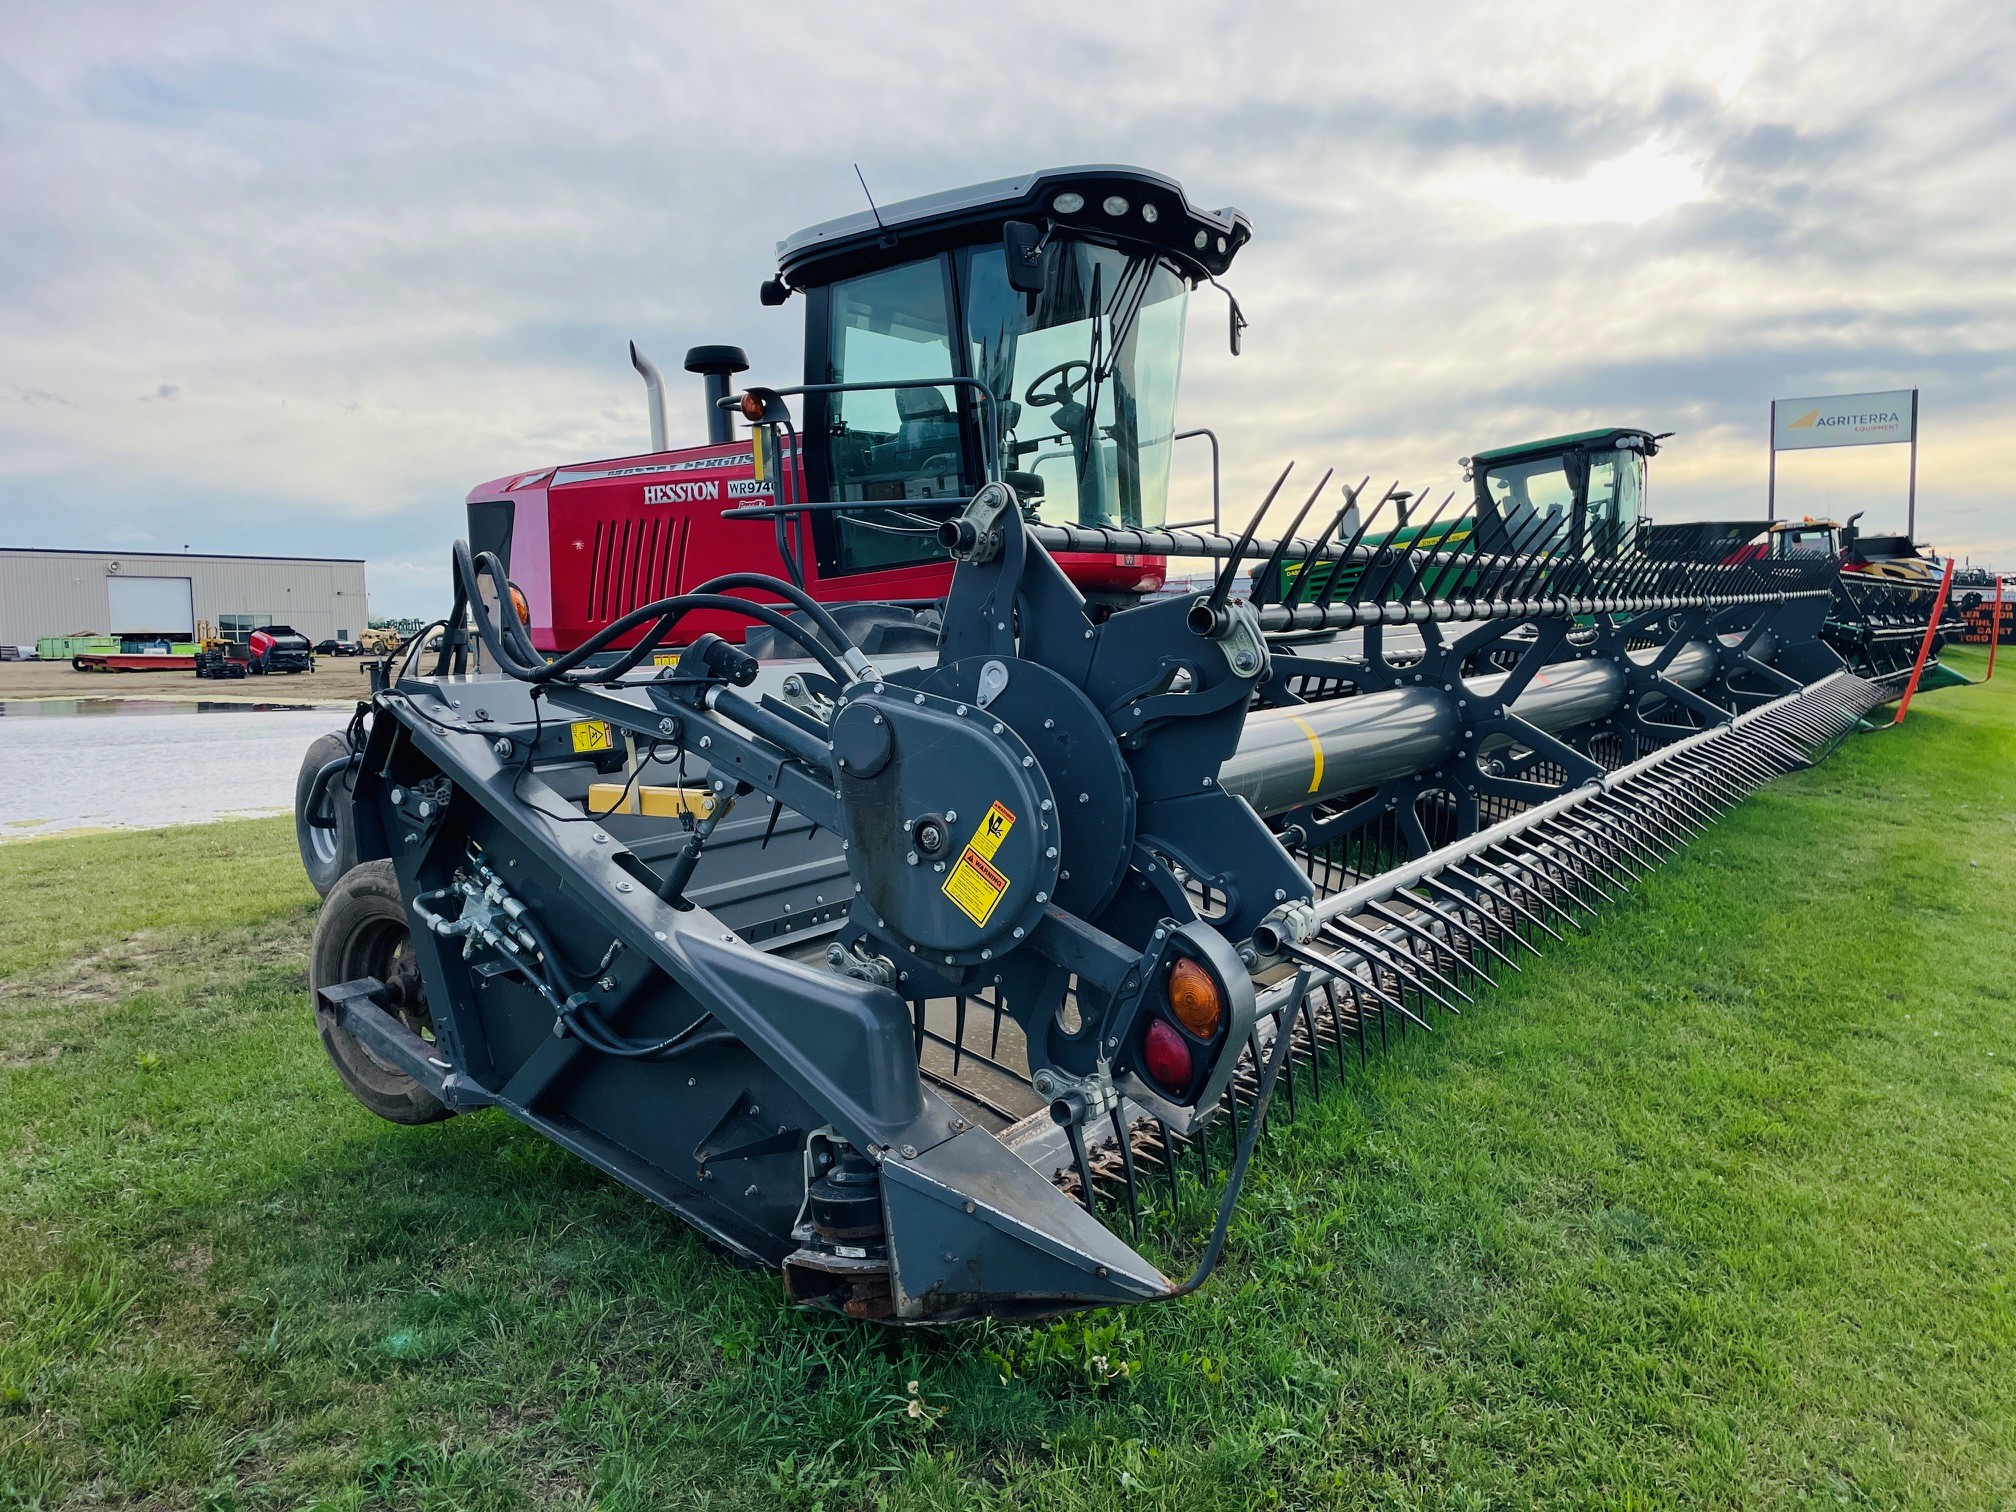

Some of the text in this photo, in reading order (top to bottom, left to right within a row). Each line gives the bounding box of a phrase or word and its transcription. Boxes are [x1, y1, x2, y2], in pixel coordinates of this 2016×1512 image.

[1816, 412, 1899, 427] AGRITERRA
[1854, 424, 1899, 432] EQUIPMENT
[643, 481, 719, 505] HESSTON
[1977, 627, 2013, 635] CAET
[975, 860, 1002, 887] WARNING
